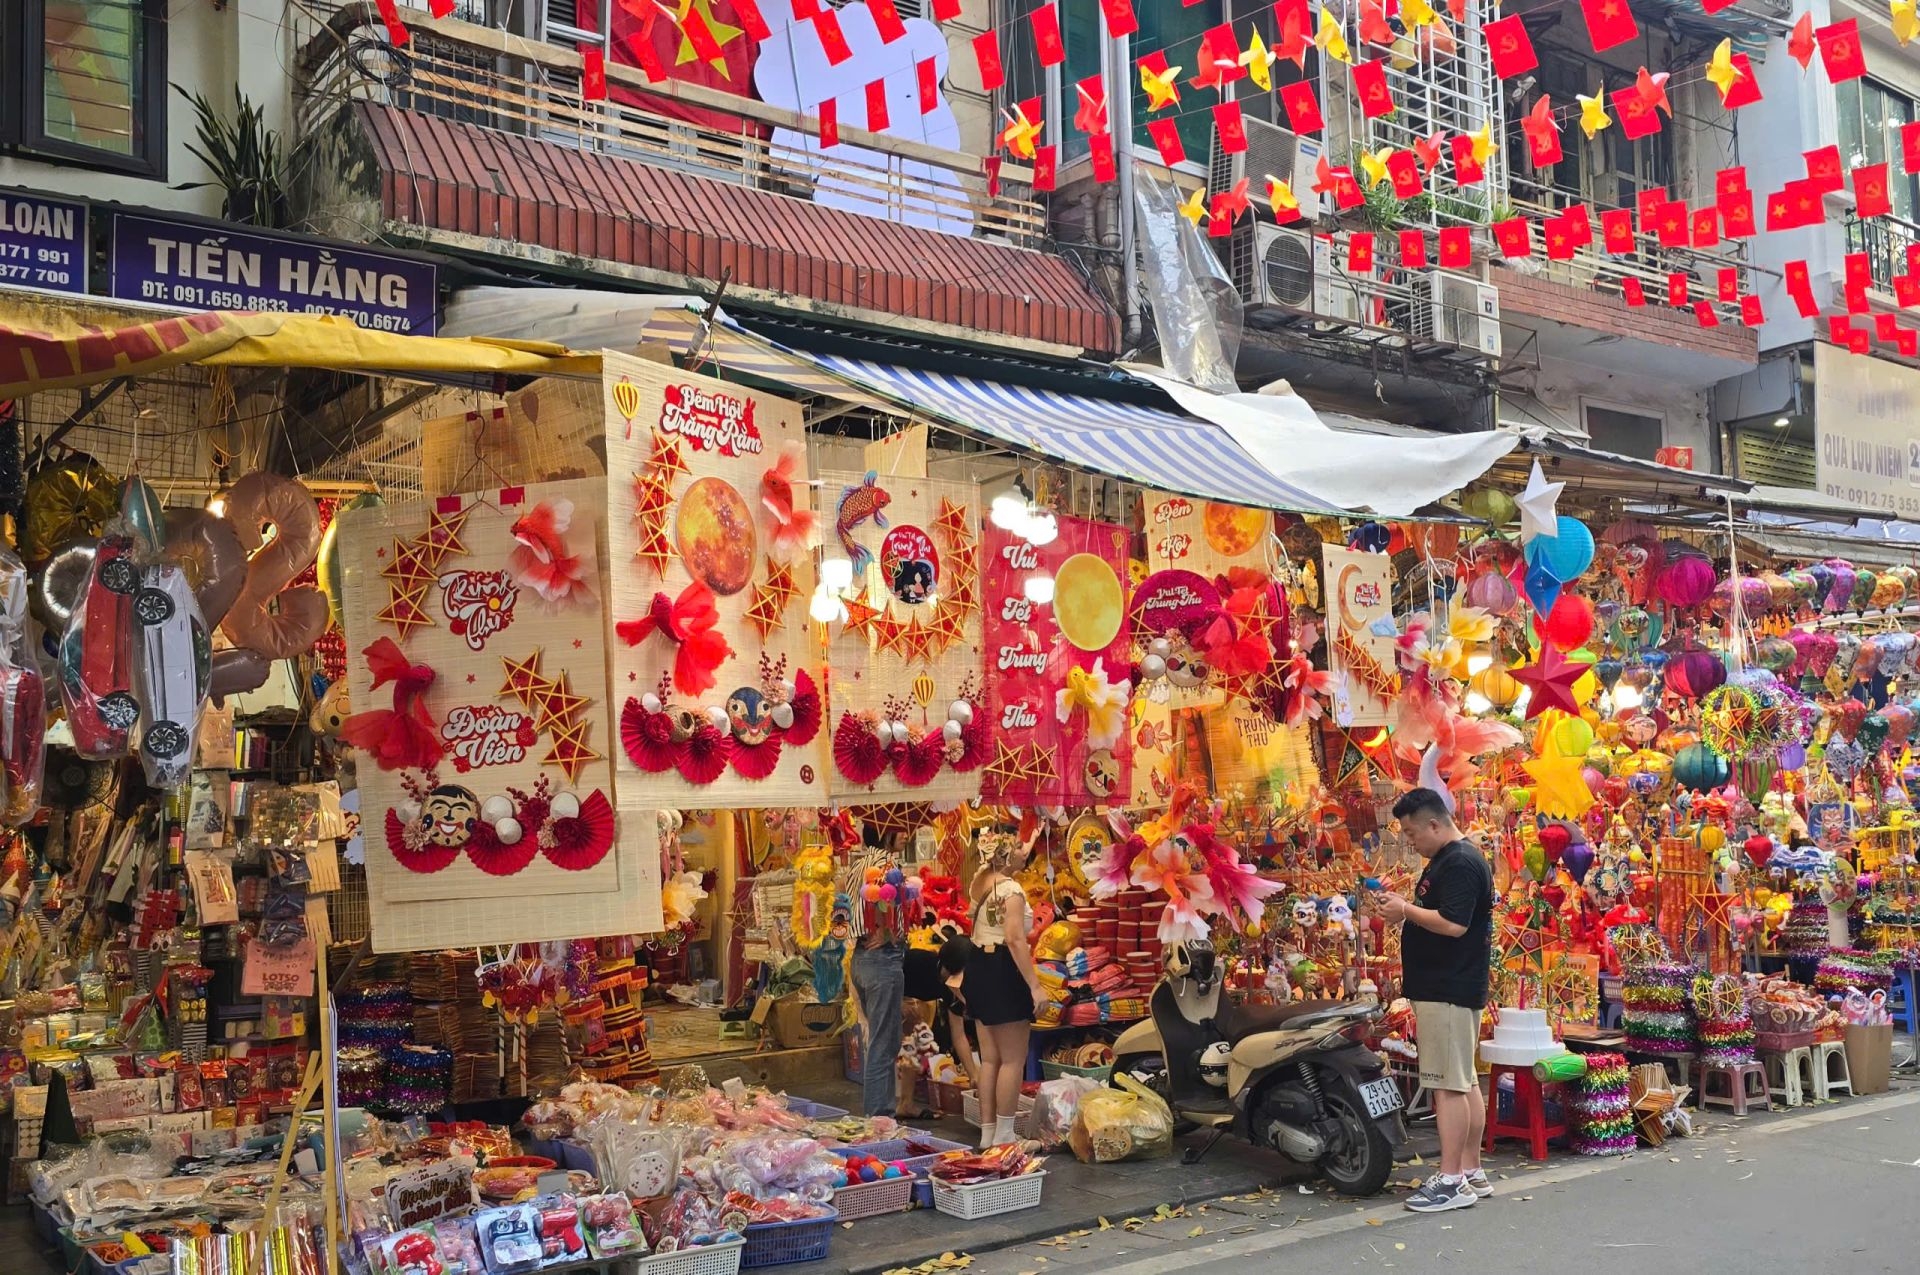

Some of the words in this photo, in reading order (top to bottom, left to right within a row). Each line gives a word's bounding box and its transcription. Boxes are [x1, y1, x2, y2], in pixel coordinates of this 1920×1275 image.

[0, 200, 74, 240] LOAN
[38, 249, 69, 265] 991
[36, 268, 70, 284] 700
[148, 237, 261, 288] TIẾN
[279, 251, 408, 309] HẰNG
[142, 280, 169, 299] ĐT:
[174, 285, 288, 312] 091.659.8833
[679, 386, 717, 414] Đêm
[714, 395, 743, 420] Hội
[662, 403, 716, 450] Trăng
[716, 418, 762, 457] Rằm
[1848, 487, 1877, 506] 0912
[1881, 493, 1895, 508] 75
[1003, 543, 1038, 569] Vui
[998, 643, 1049, 675] Trung
[442, 706, 522, 740] Đoàn
[1002, 702, 1037, 729] Thu
[456, 733, 523, 766] Viên
[1247, 733, 1268, 748] THU
[262, 973, 300, 982] LOTSO
[1369, 1093, 1403, 1115] 319.49
